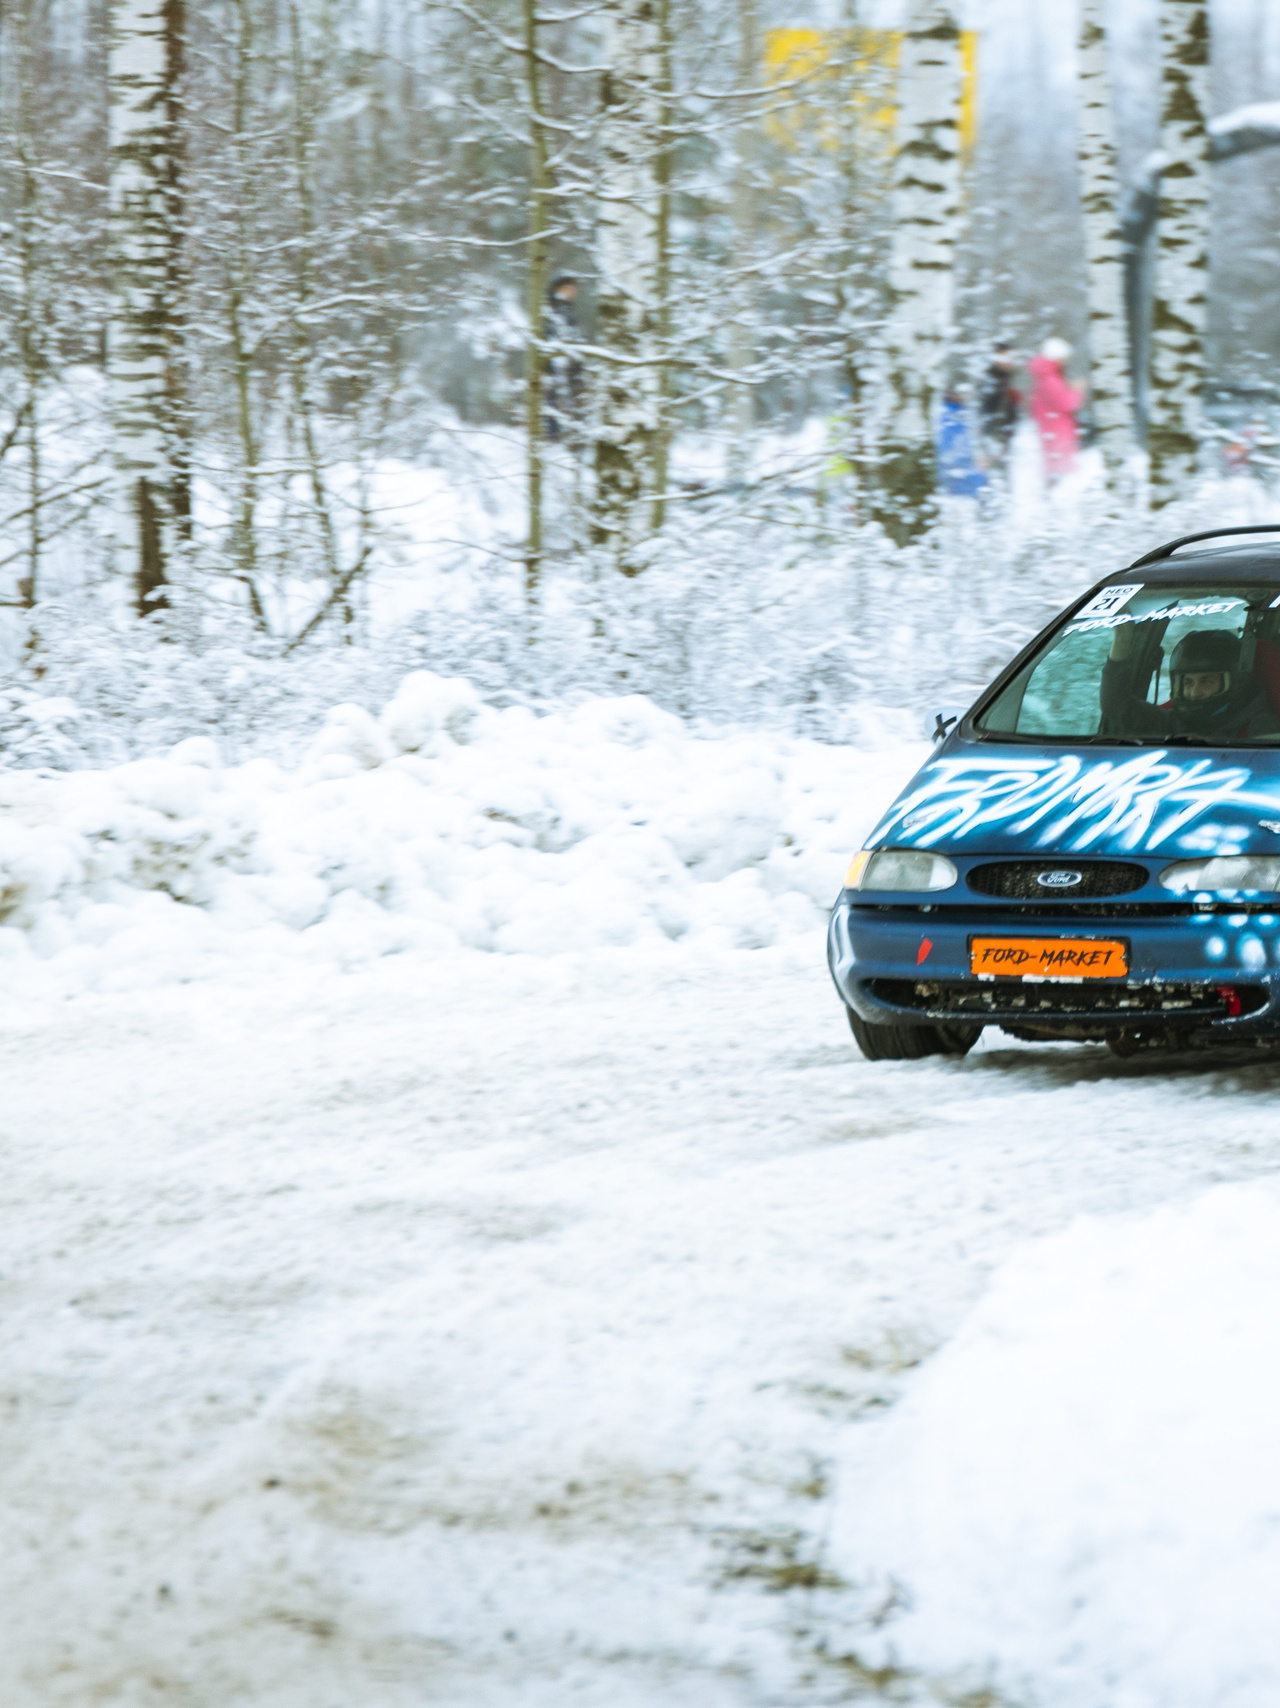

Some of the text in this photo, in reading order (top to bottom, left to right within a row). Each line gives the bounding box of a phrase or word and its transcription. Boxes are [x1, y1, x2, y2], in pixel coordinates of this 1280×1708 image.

[1104, 587, 1133, 596] NEO
[1091, 597, 1120, 611] 21
[1062, 600, 1247, 637] FORD-MARKET
[982, 948, 1115, 967] FORD-MARKET
